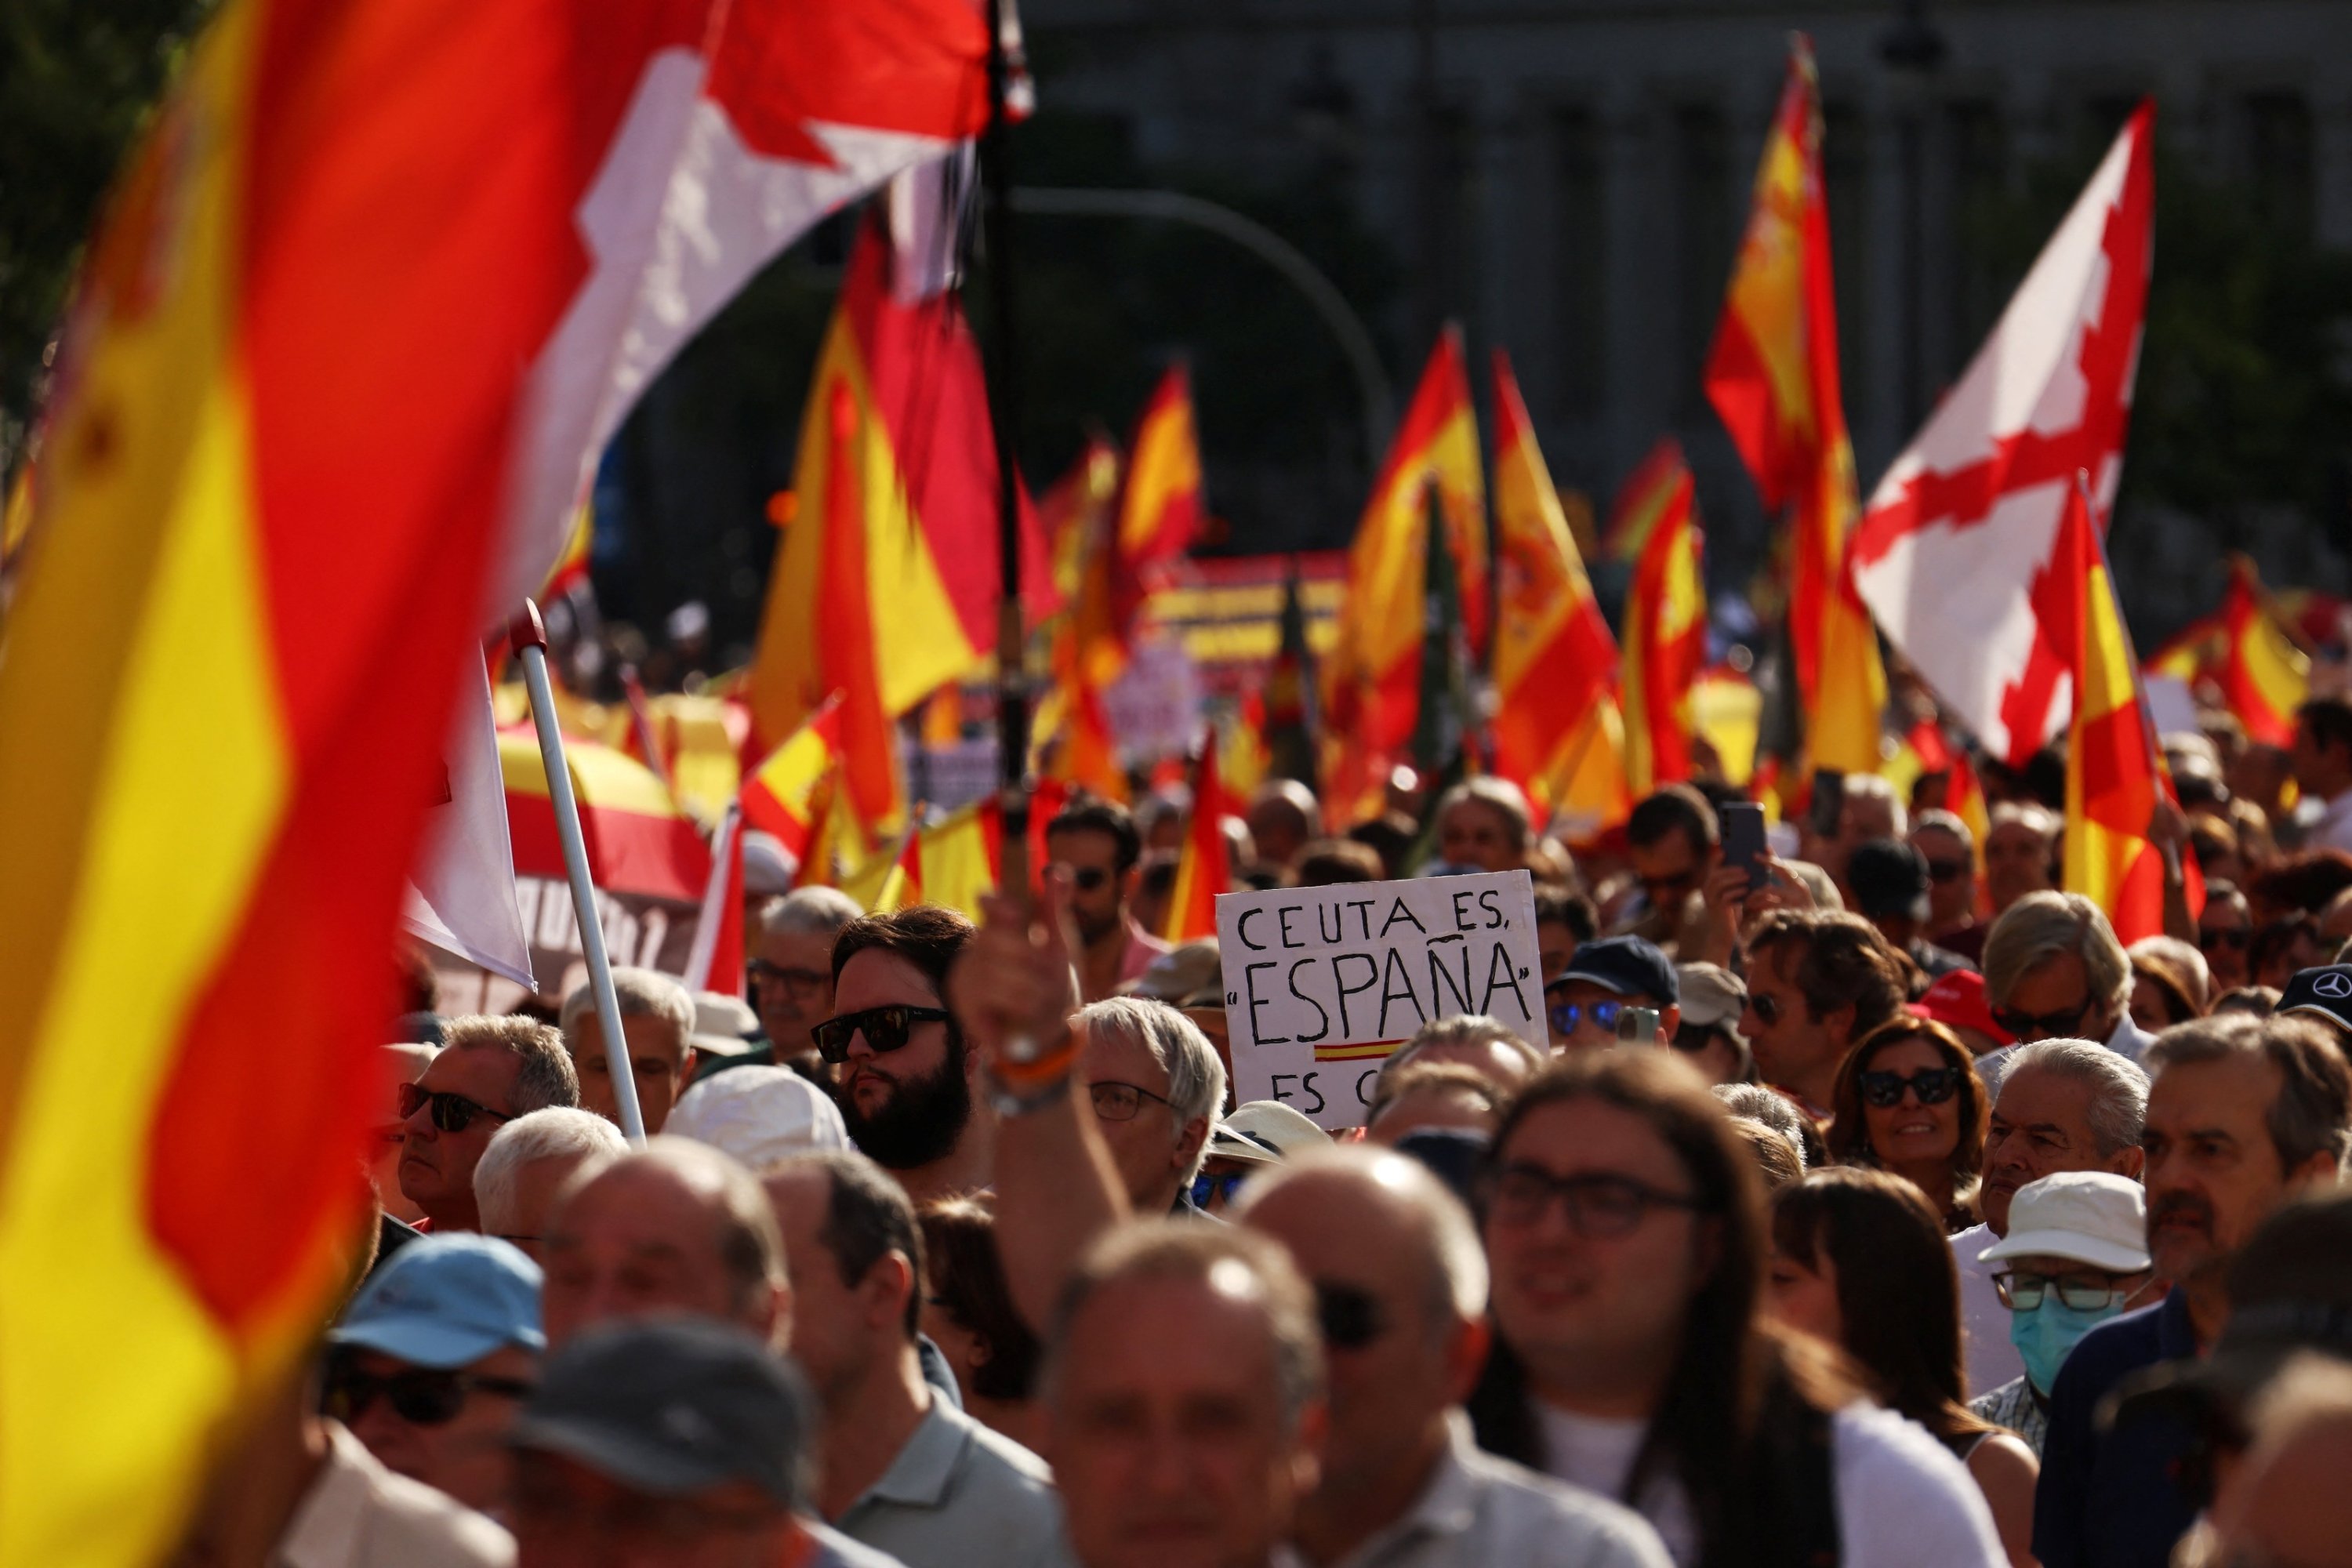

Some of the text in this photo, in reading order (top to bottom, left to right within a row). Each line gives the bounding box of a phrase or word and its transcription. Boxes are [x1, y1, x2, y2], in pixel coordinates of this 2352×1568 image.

[1237, 890, 1509, 951] CEUTA ES,
[1272, 1071, 1326, 1114] ES
